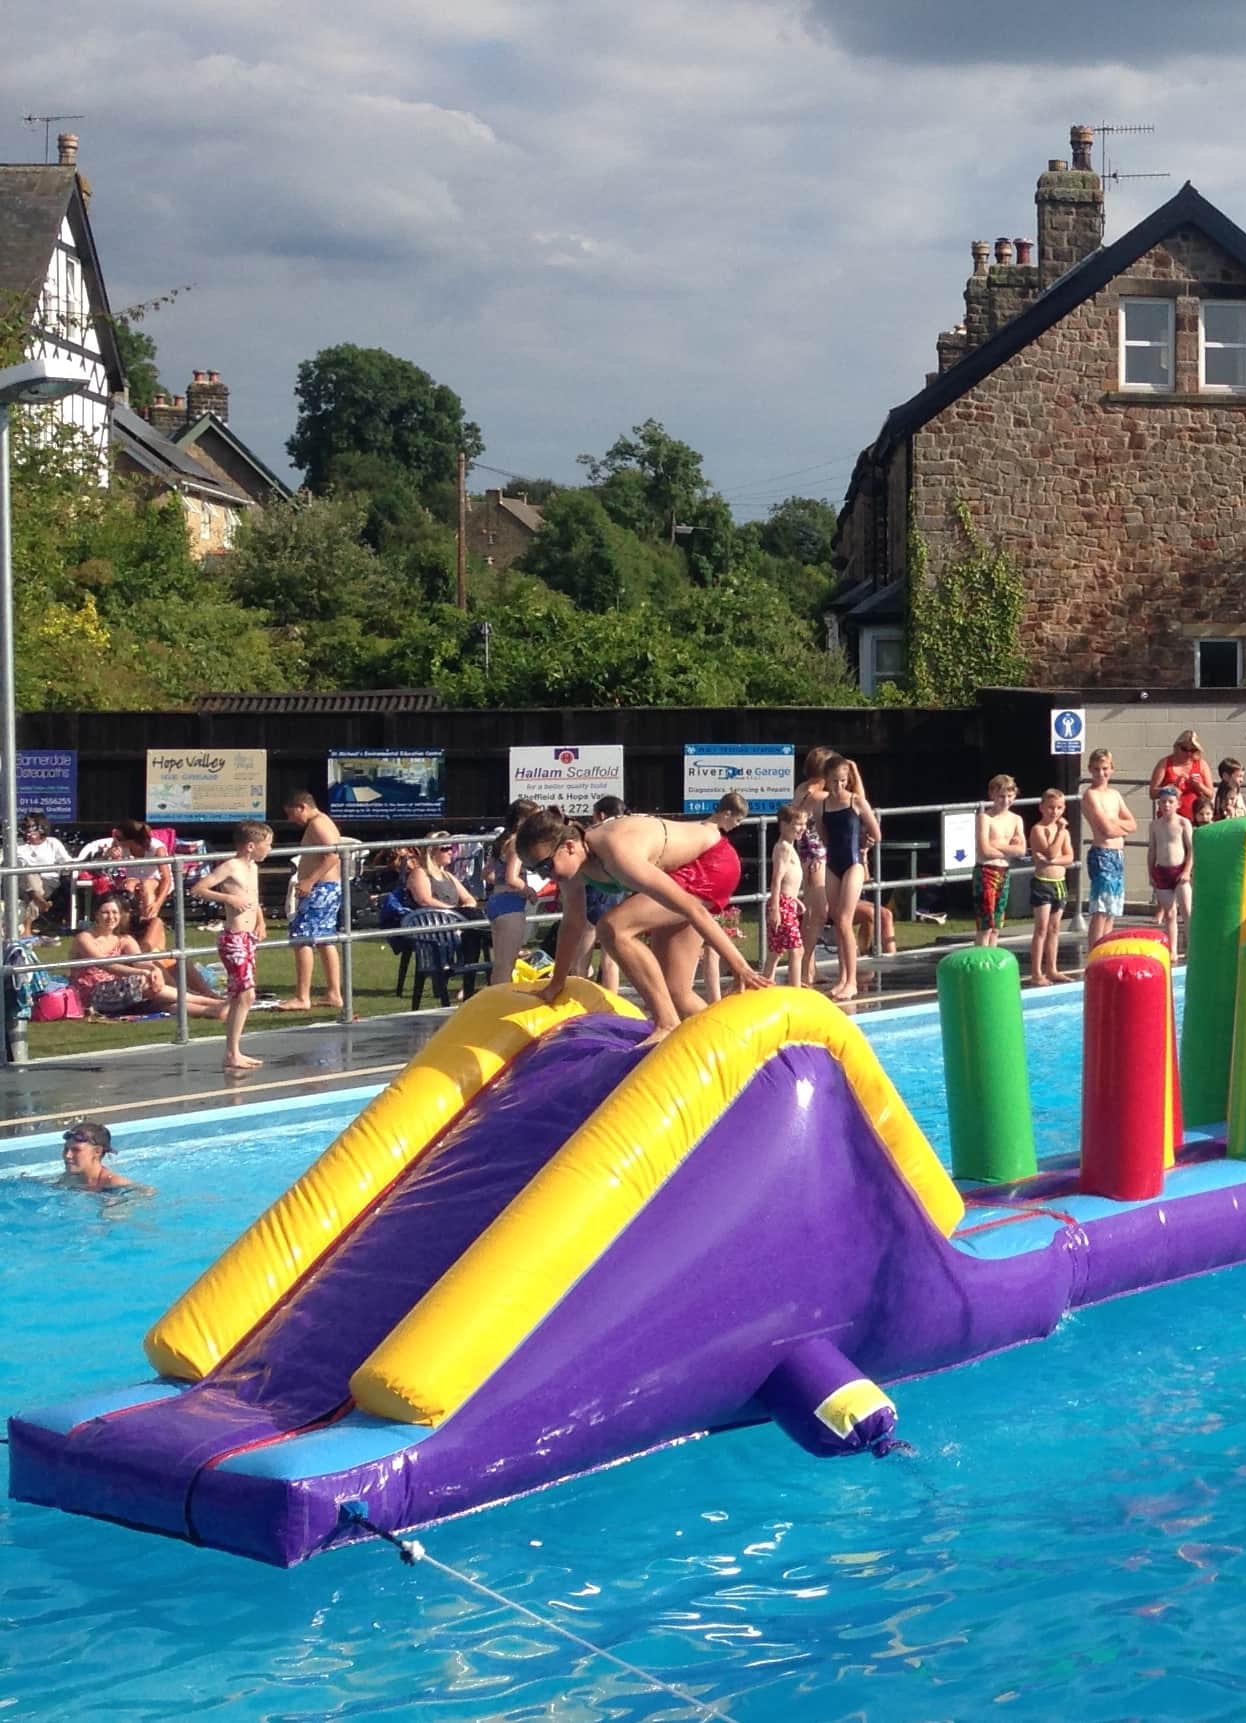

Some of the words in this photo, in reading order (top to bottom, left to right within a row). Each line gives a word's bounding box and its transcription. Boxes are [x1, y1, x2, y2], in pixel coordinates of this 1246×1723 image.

[152, 755, 183, 773] Hope
[186, 753, 226, 773] Valley
[515, 767, 562, 778] Hallam
[566, 766, 619, 778] Scaffold
[688, 767, 753, 777] Riverde
[754, 767, 791, 778] Garage
[566, 793, 589, 801] Hope
[569, 804, 589, 813] 272
